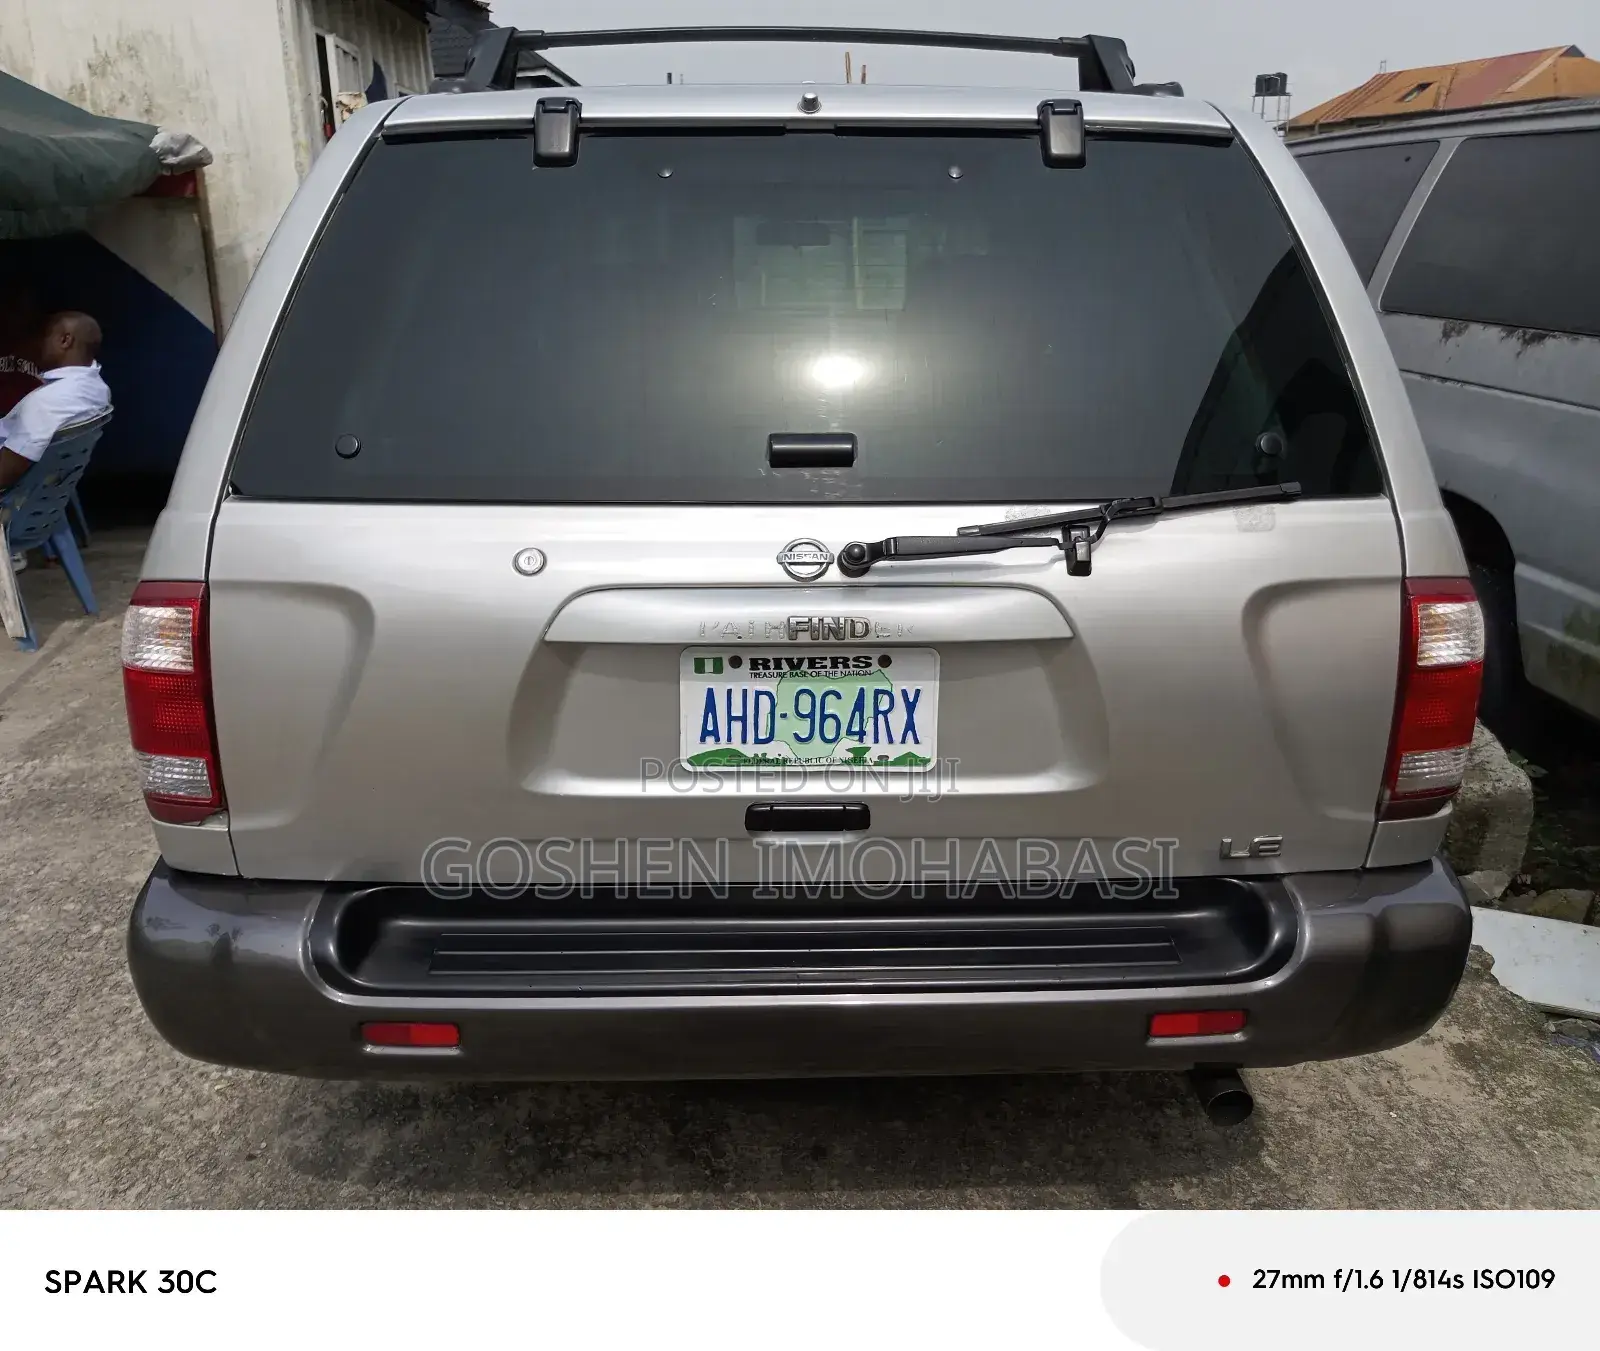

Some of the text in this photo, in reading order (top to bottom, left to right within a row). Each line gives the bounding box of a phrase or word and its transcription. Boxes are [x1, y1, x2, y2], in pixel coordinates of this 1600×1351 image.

[783, 552, 829, 562] NISSAN
[749, 655, 873, 671] RIVERS
[750, 671, 787, 679] TREASURE
[840, 669, 872, 677] NATION
[699, 686, 921, 745] AHD-964RX
[743, 757, 781, 765] FEDERAL
[825, 756, 838, 764] OF
[1220, 834, 1283, 859] LE
